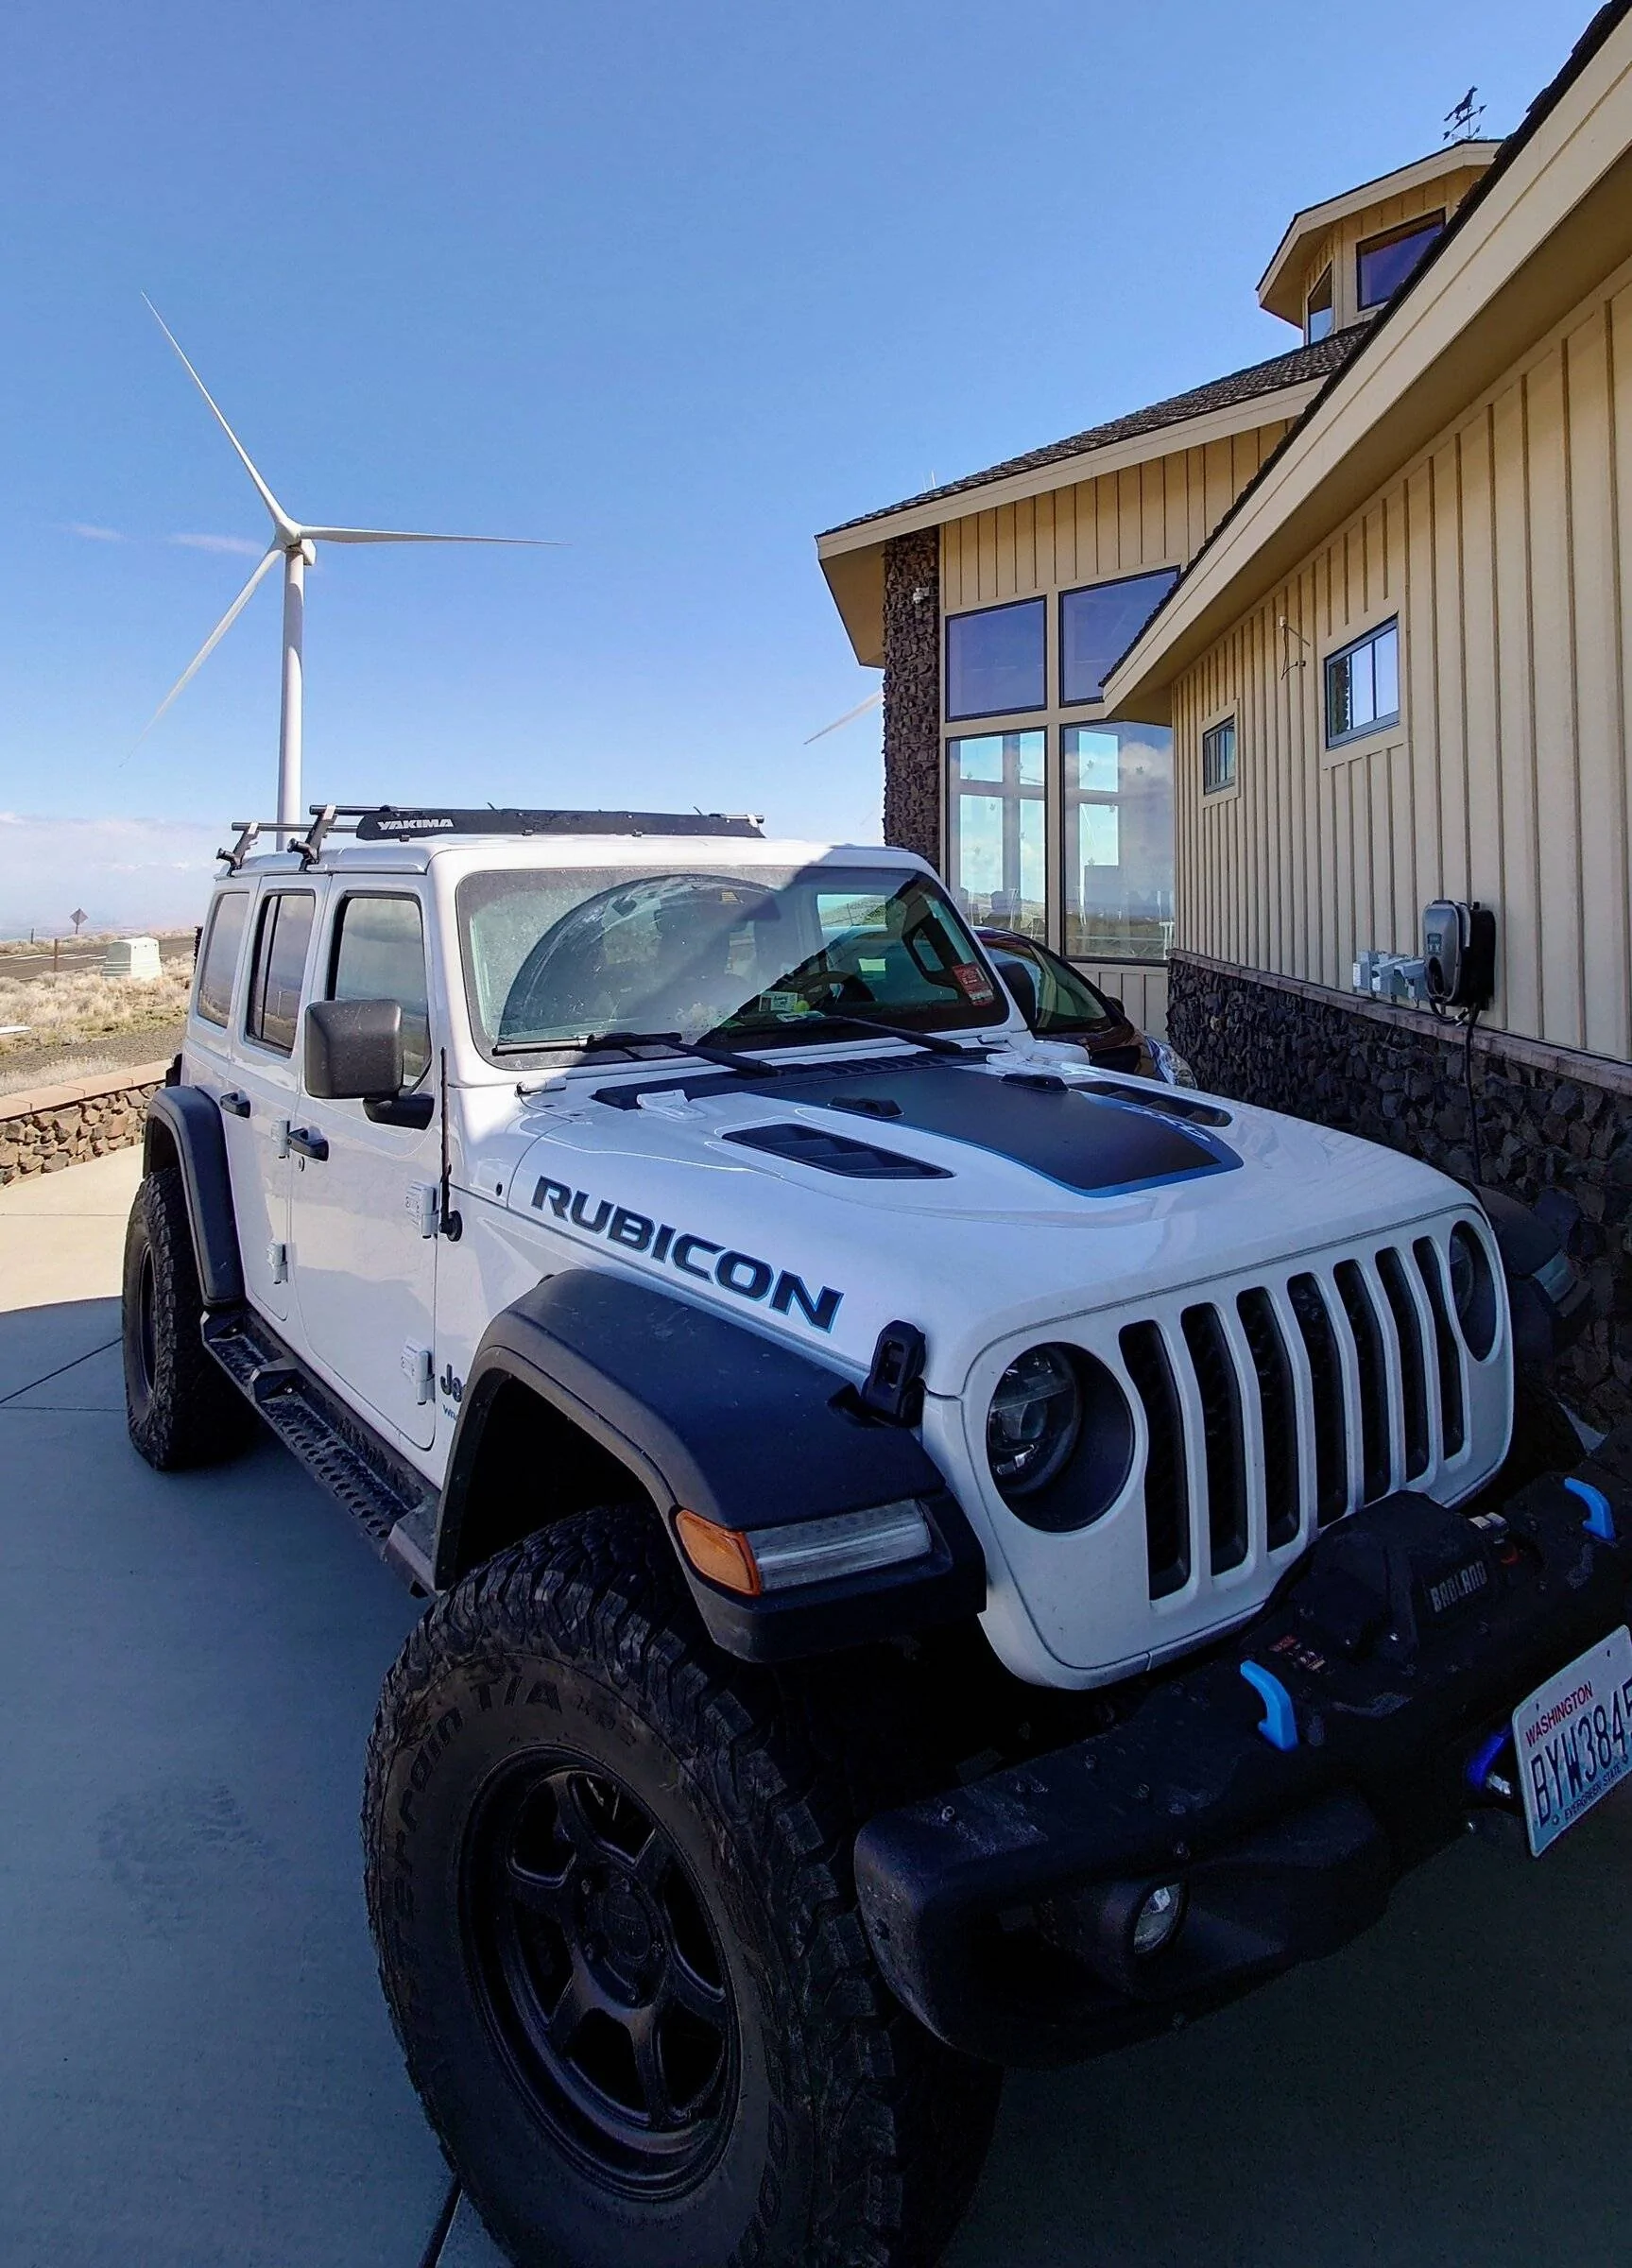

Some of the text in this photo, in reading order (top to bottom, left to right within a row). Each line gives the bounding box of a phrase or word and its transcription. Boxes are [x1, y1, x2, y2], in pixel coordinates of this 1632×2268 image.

[378, 818, 454, 831] YAKIMA
[530, 1175, 845, 1333] RUBICON
[439, 1364, 468, 1403] Je
[1430, 1560, 1488, 1612] BADLAND
[1525, 1679, 1594, 1748] WASHINGTON
[1564, 1762, 1623, 1821] EVERGREEN STATE
